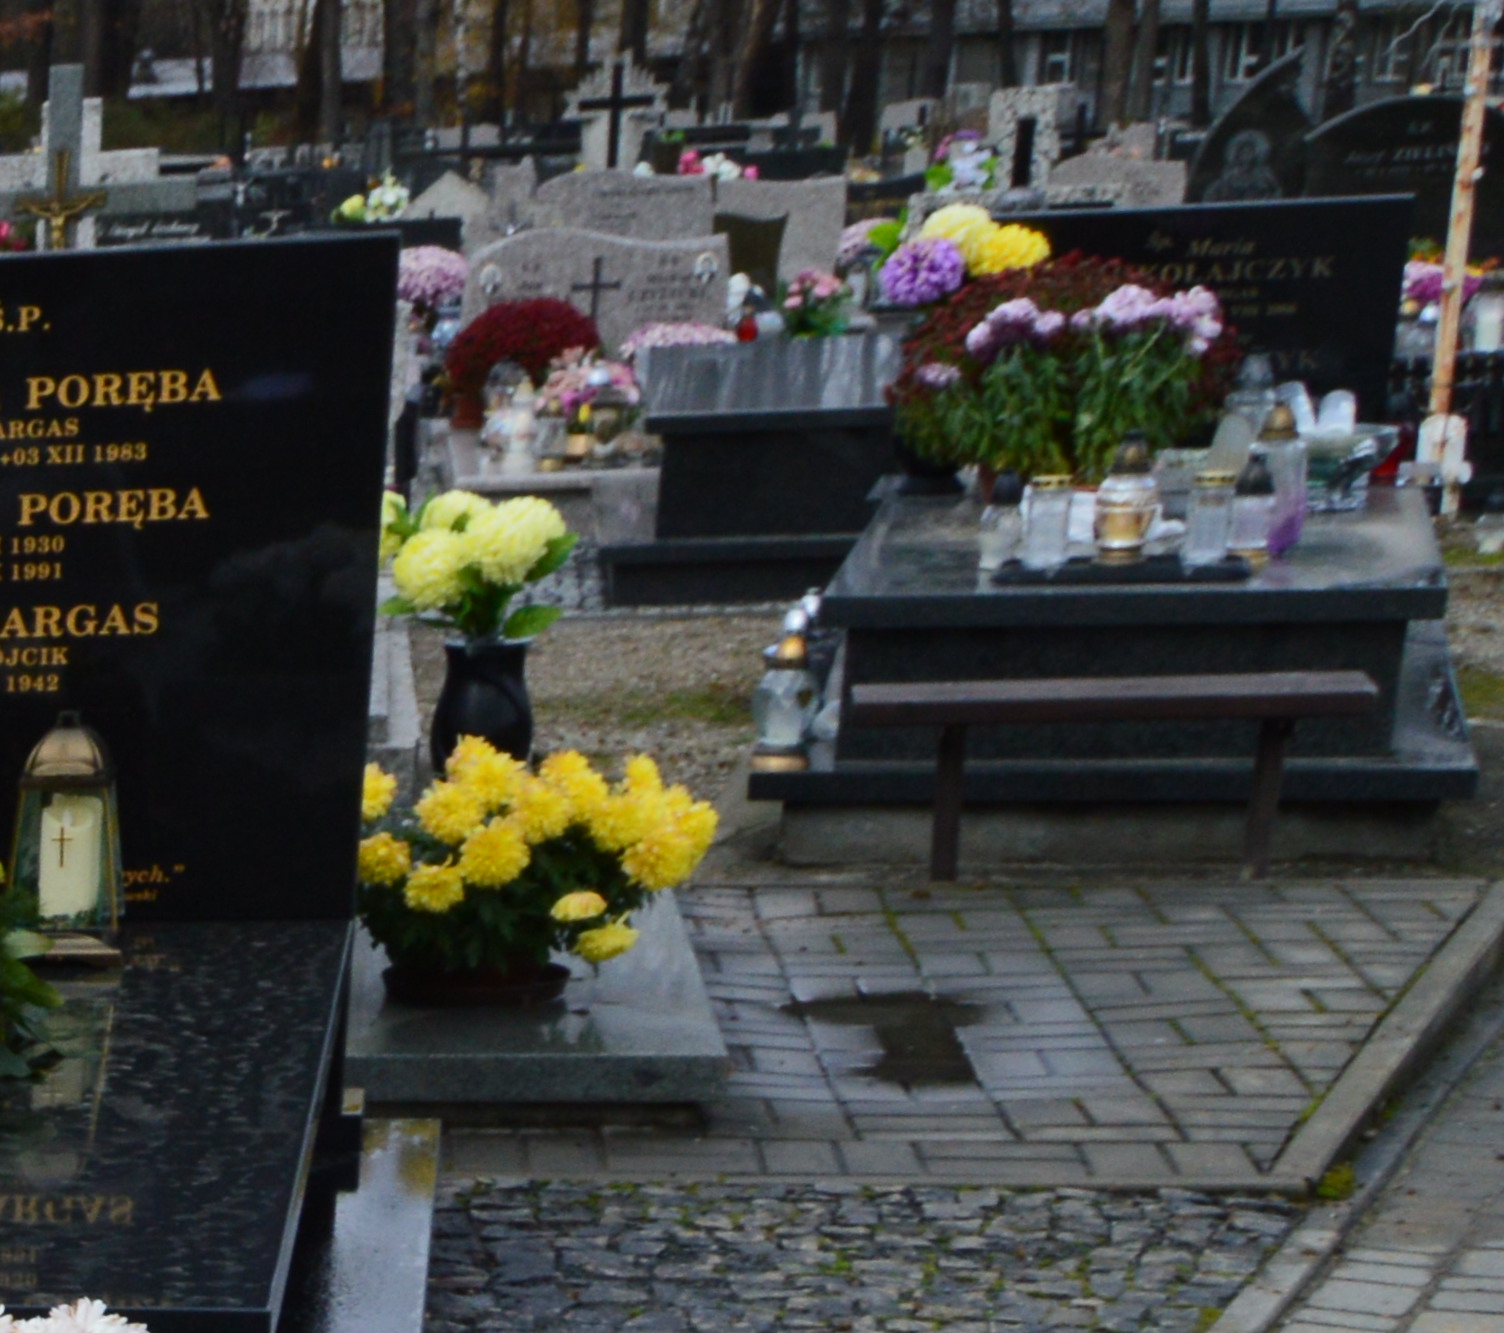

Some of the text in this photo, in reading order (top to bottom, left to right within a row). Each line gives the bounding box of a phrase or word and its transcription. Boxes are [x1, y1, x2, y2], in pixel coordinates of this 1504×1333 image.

[1143, 255, 1336, 284] KOŁAJCZYK
[26, 369, 221, 412] PORĘBA
[47, 445, 84, 464] XII
[95, 443, 147, 462] 1983
[18, 488, 209, 529] PORĘBA
[12, 536, 64, 554] 1930
[12, 563, 61, 580] 1991
[8, 674, 59, 692] 1942
